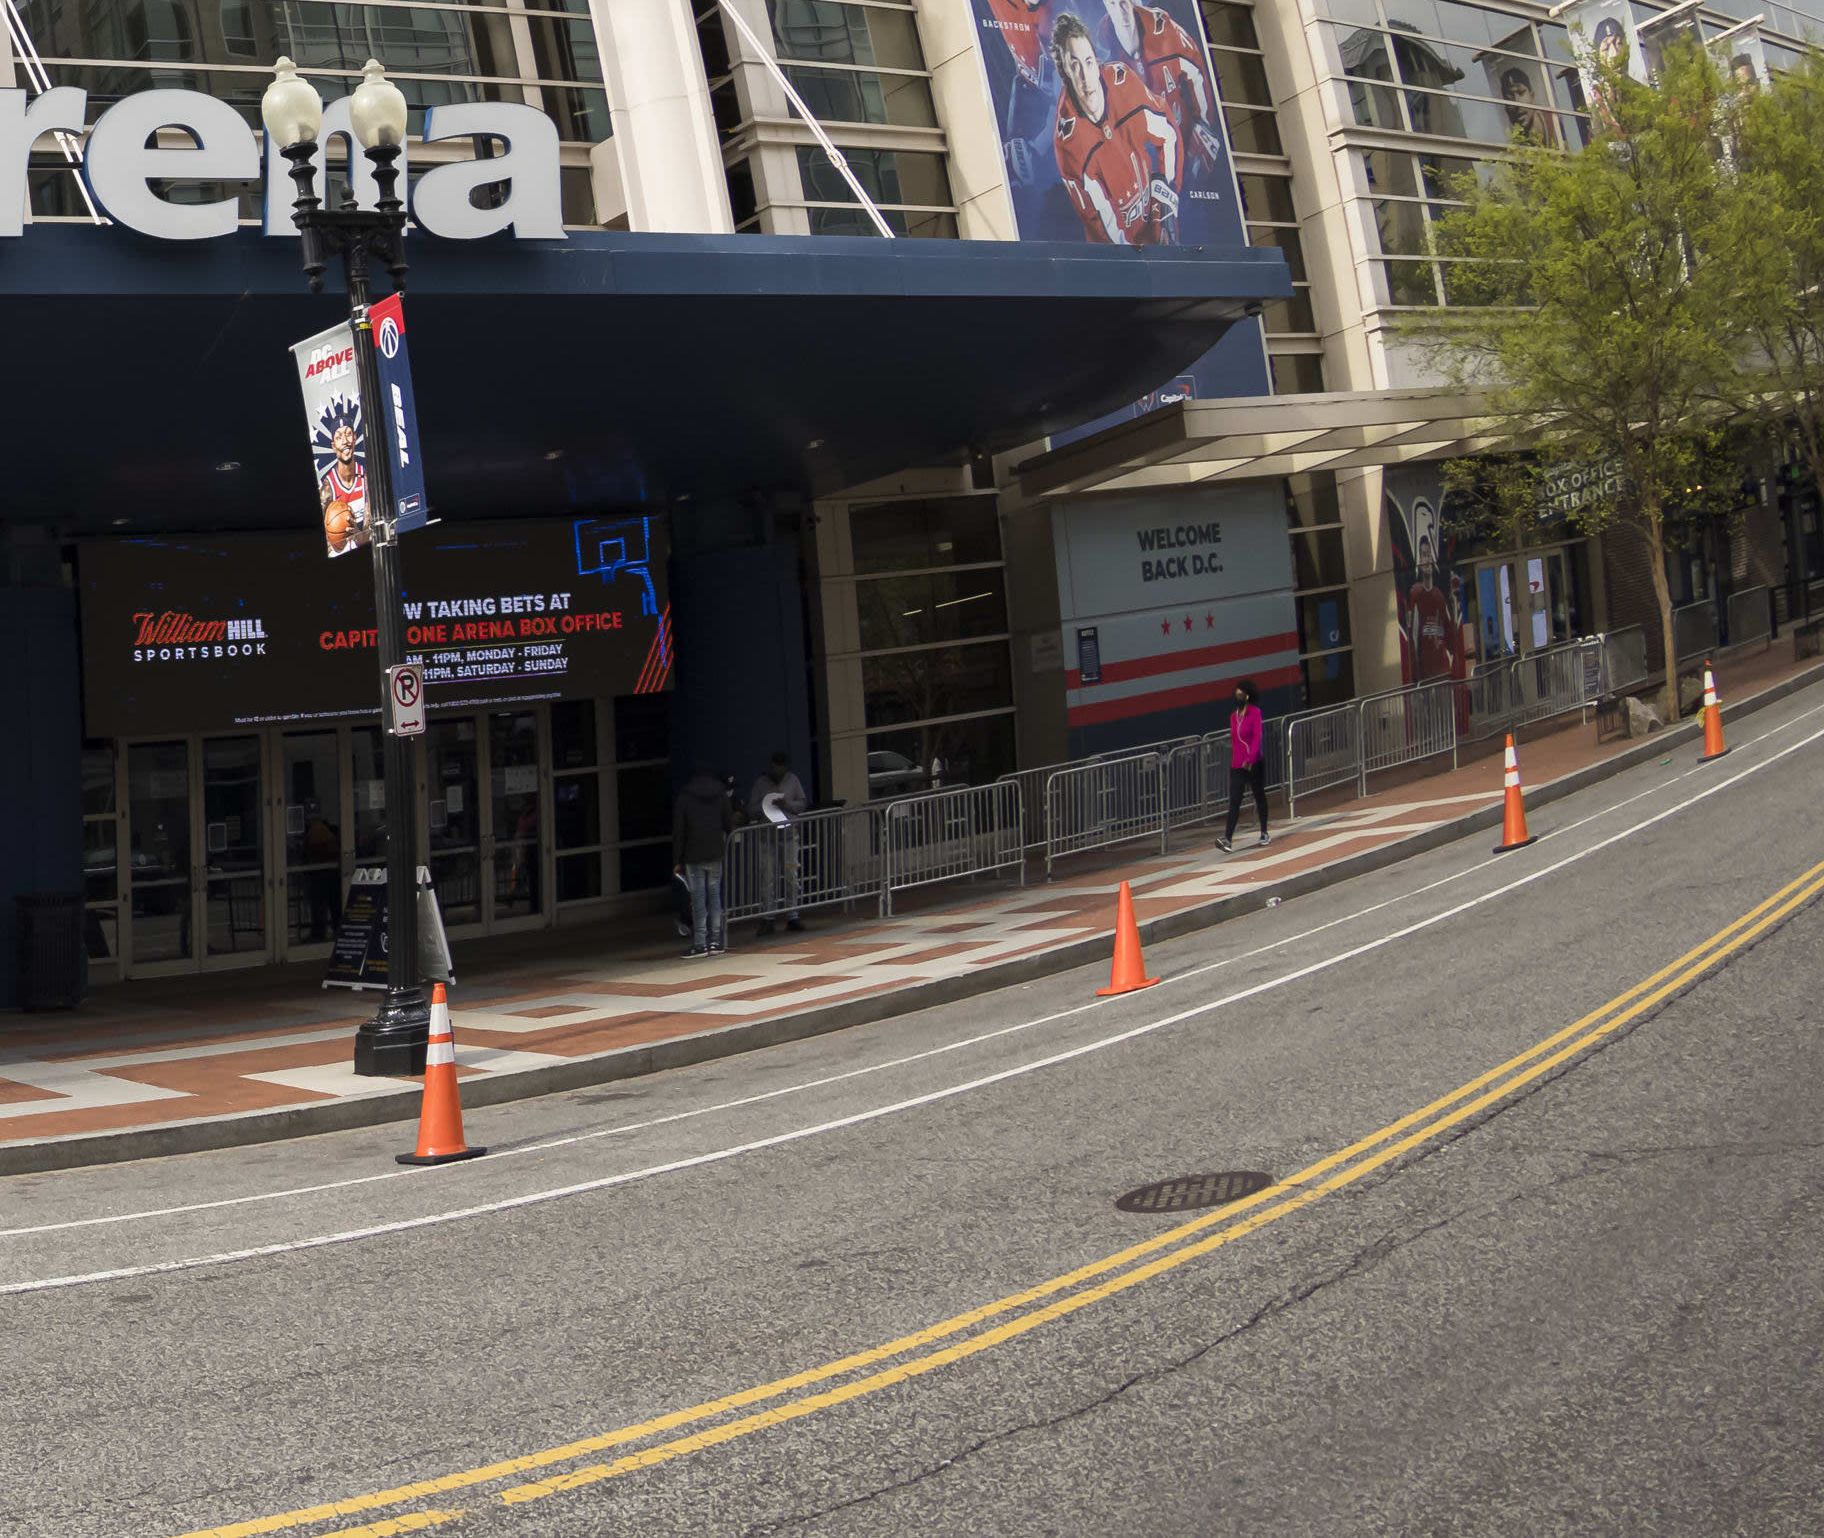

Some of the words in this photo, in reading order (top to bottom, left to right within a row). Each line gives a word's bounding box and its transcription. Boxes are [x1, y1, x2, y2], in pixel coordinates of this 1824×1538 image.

[304, 346, 354, 380] ABOVE
[390, 382, 410, 469] BEAL
[1136, 522, 1222, 552] WELCOME
[1141, 555, 1189, 583] BACK
[1191, 551, 1224, 576] D.C.
[426, 597, 496, 619] TAKING
[501, 595, 545, 614] BETS
[549, 592, 572, 610] AT
[132, 611, 227, 647] William
[227, 619, 267, 641] HILL
[319, 628, 379, 651] CAPIT
[406, 624, 447, 645] ONE
[452, 619, 516, 642] ARENA
[519, 616, 557, 636] BOX
[560, 611, 623, 634] OFFICE
[133, 642, 267, 662] SPORTSBOOK
[432, 652, 464, 665] 11PM,
[465, 648, 516, 662] MONDAY
[523, 643, 564, 657] FRIDAY
[456, 662, 515, 678] SATURDAY
[523, 657, 569, 672] SUNDAY
